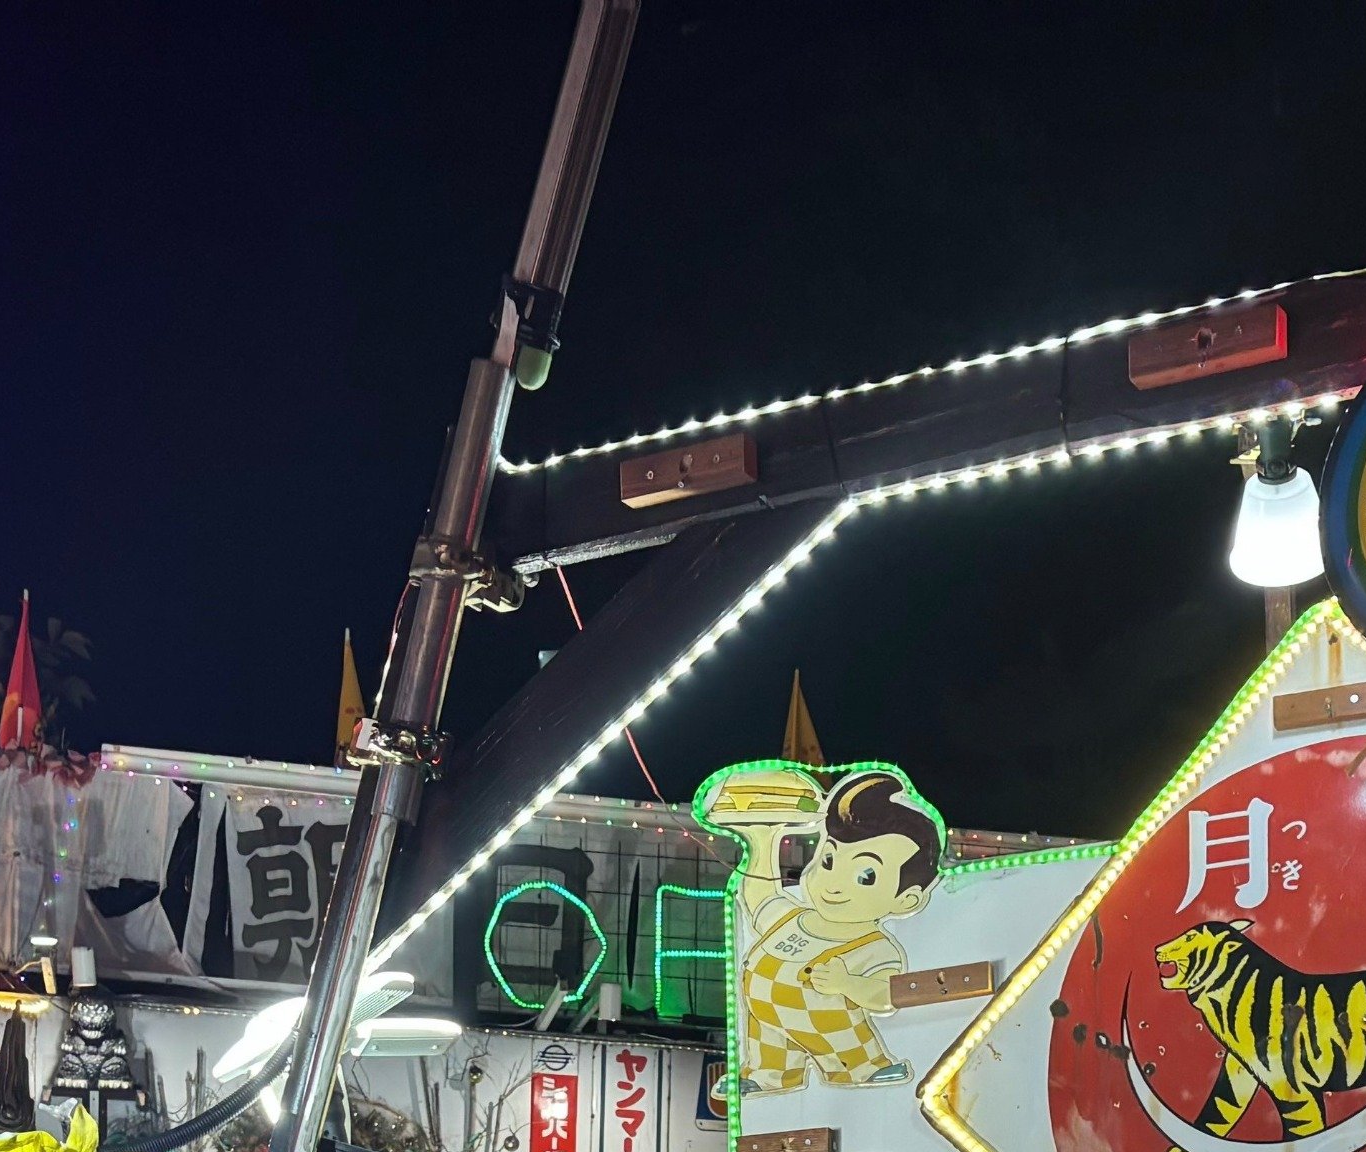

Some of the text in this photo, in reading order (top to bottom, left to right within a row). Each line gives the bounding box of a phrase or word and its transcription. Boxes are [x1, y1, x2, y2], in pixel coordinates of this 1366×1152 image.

[1175, 797, 1276, 914] 月
[787, 933, 810, 948] BIG
[775, 941, 803, 957] BOY
